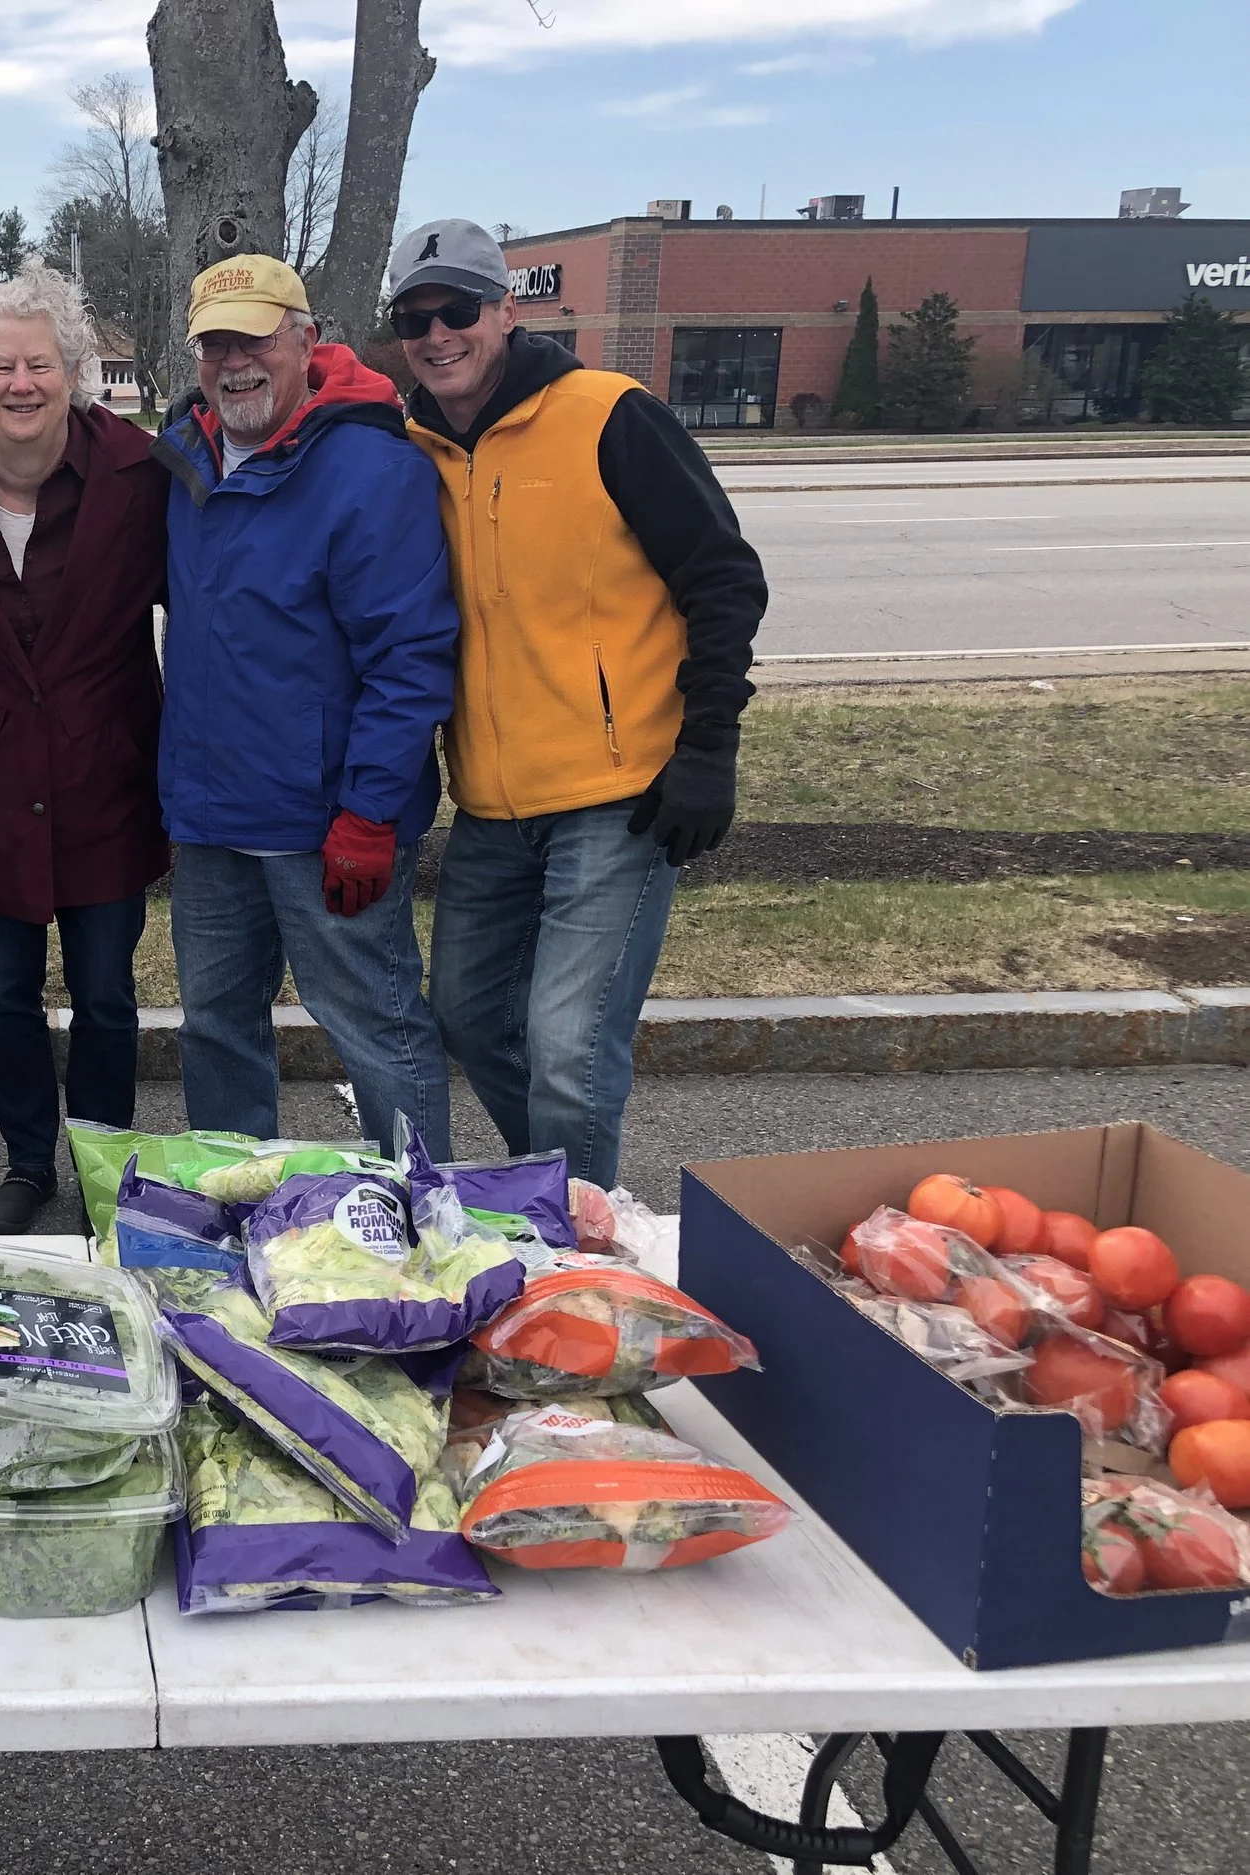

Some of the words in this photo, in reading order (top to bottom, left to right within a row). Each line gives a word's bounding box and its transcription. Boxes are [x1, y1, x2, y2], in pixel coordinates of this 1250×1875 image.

[236, 268, 253, 277] MY
[201, 276, 254, 295] ATTITUDE?
[509, 264, 556, 296] PERCUTS
[35, 1311, 59, 1323] LEAF
[18, 1322, 111, 1348] GREEN
[17, 1365, 46, 1374] FARMS
[37, 1358, 97, 1372] SINGLE
[52, 1370, 80, 1379] FRESH
